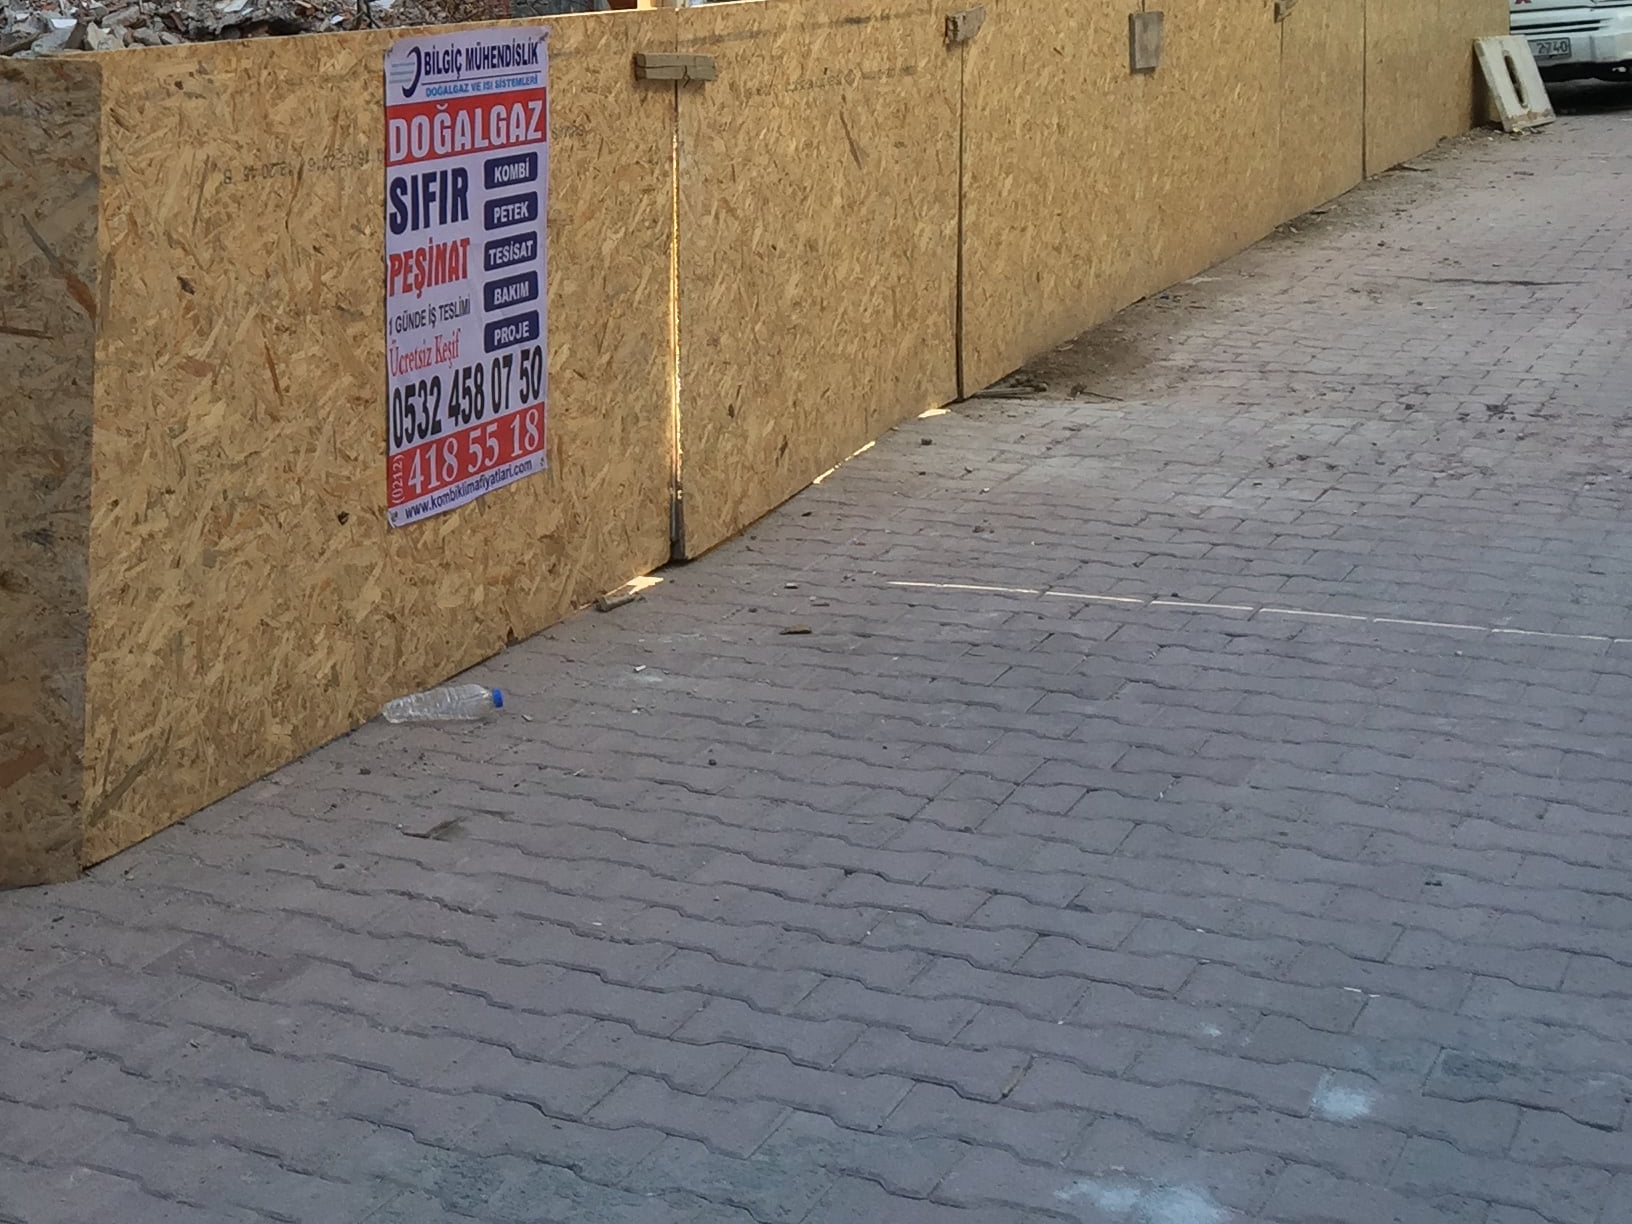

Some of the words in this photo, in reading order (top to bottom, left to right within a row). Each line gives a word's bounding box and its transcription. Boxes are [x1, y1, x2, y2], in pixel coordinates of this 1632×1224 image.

[424, 43, 463, 79] BİLGİÇ
[465, 36, 539, 72] MÜHENDİSLİK
[425, 82, 469, 97] DOĞALGAZ
[471, 81, 482, 92] VE
[483, 80, 493, 90] ISI
[495, 74, 538, 89] SİSTEMLERİ
[388, 99, 543, 163] DOĞALGAZ
[493, 159, 530, 183] KOMBİ
[388, 166, 469, 236] SIFIR
[493, 201, 529, 224] PETEK
[388, 237, 471, 298] PEŞİNAT
[488, 239, 534, 266] TESİSAT
[493, 280, 530, 305] BAKIM
[395, 309, 426, 334] GÜNDE
[428, 303, 437, 329] İŞ
[493, 320, 530, 346] PROJE
[389, 339, 432, 377] Ücretsiz
[434, 327, 462, 369] Keşif
[392, 375, 442, 449] 0532
[448, 362, 485, 427] 458
[491, 353, 514, 414] 07
[519, 344, 543, 404] 50
[408, 437, 459, 494] 418
[468, 422, 499, 473] 55
[510, 408, 540, 458] 18
[391, 454, 405, 504] (0212)
